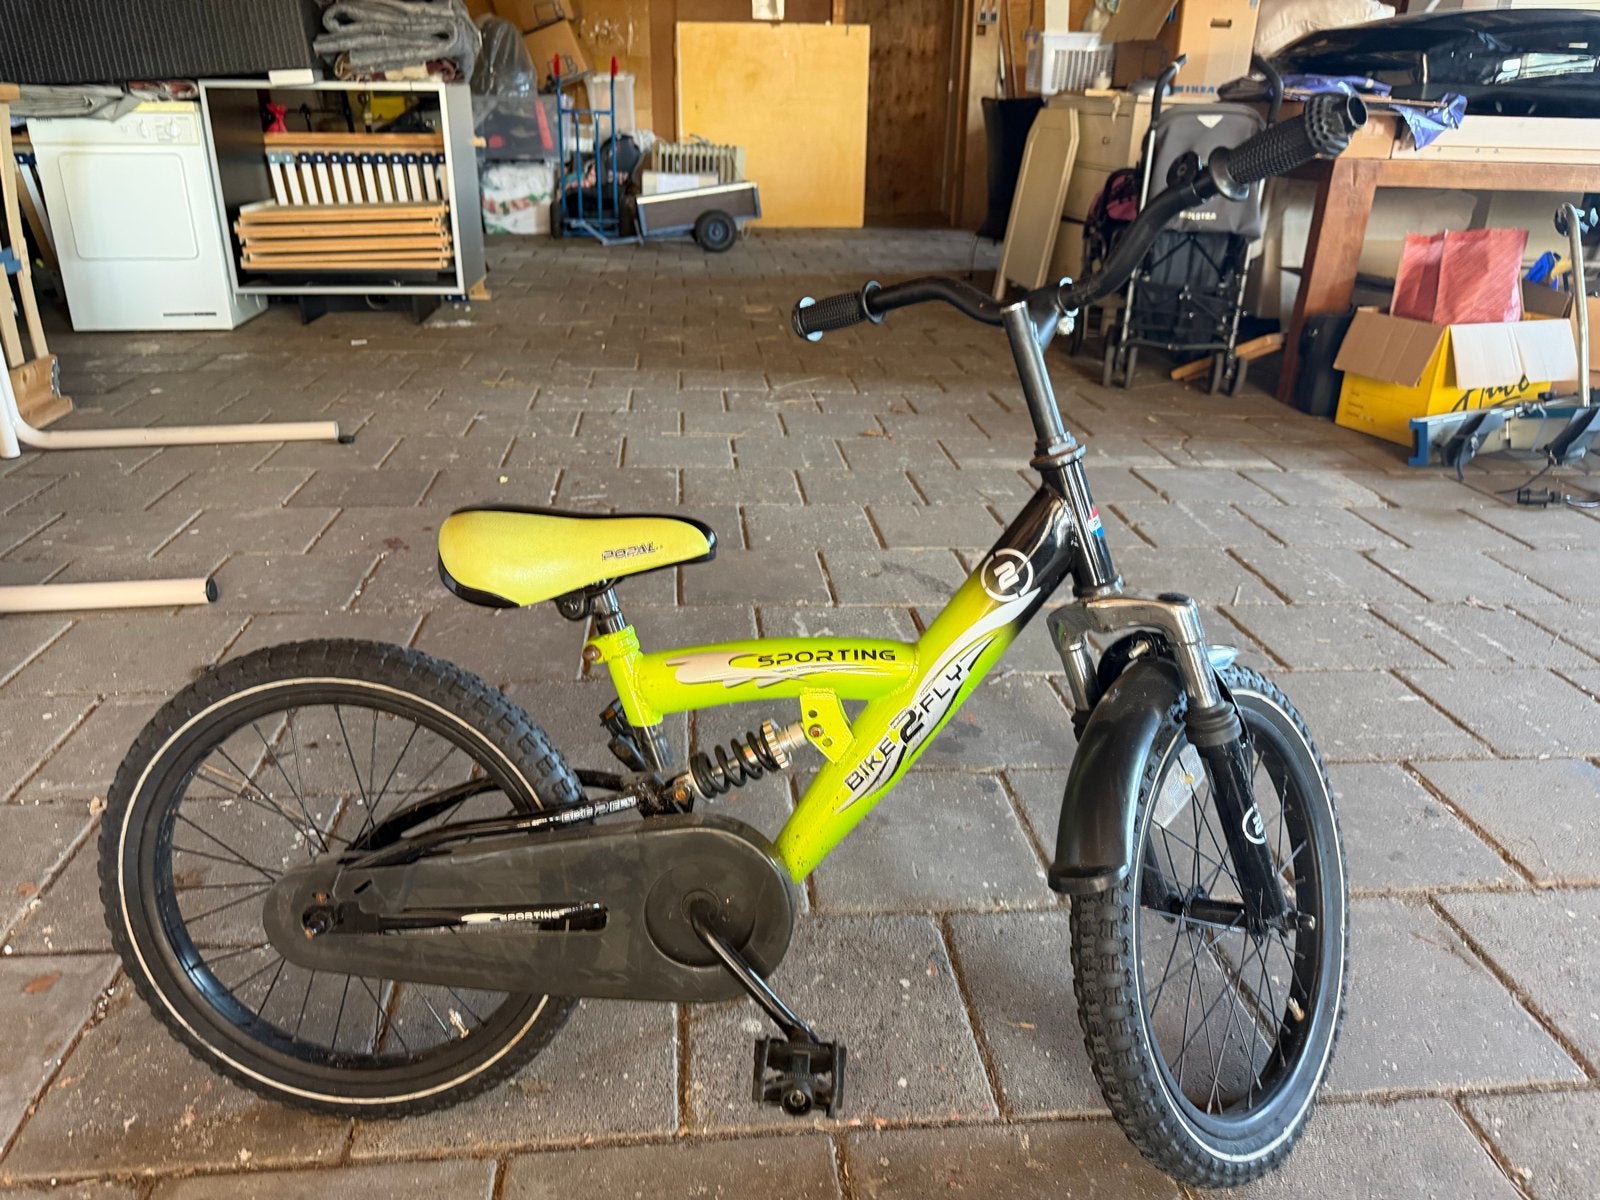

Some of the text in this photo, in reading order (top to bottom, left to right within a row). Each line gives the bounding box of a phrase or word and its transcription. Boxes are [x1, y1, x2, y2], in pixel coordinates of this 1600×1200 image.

[758, 649, 896, 667] SPORTING
[844, 737, 896, 792] BIKE
[890, 706, 925, 744] 2
[919, 664, 963, 713] FLY
